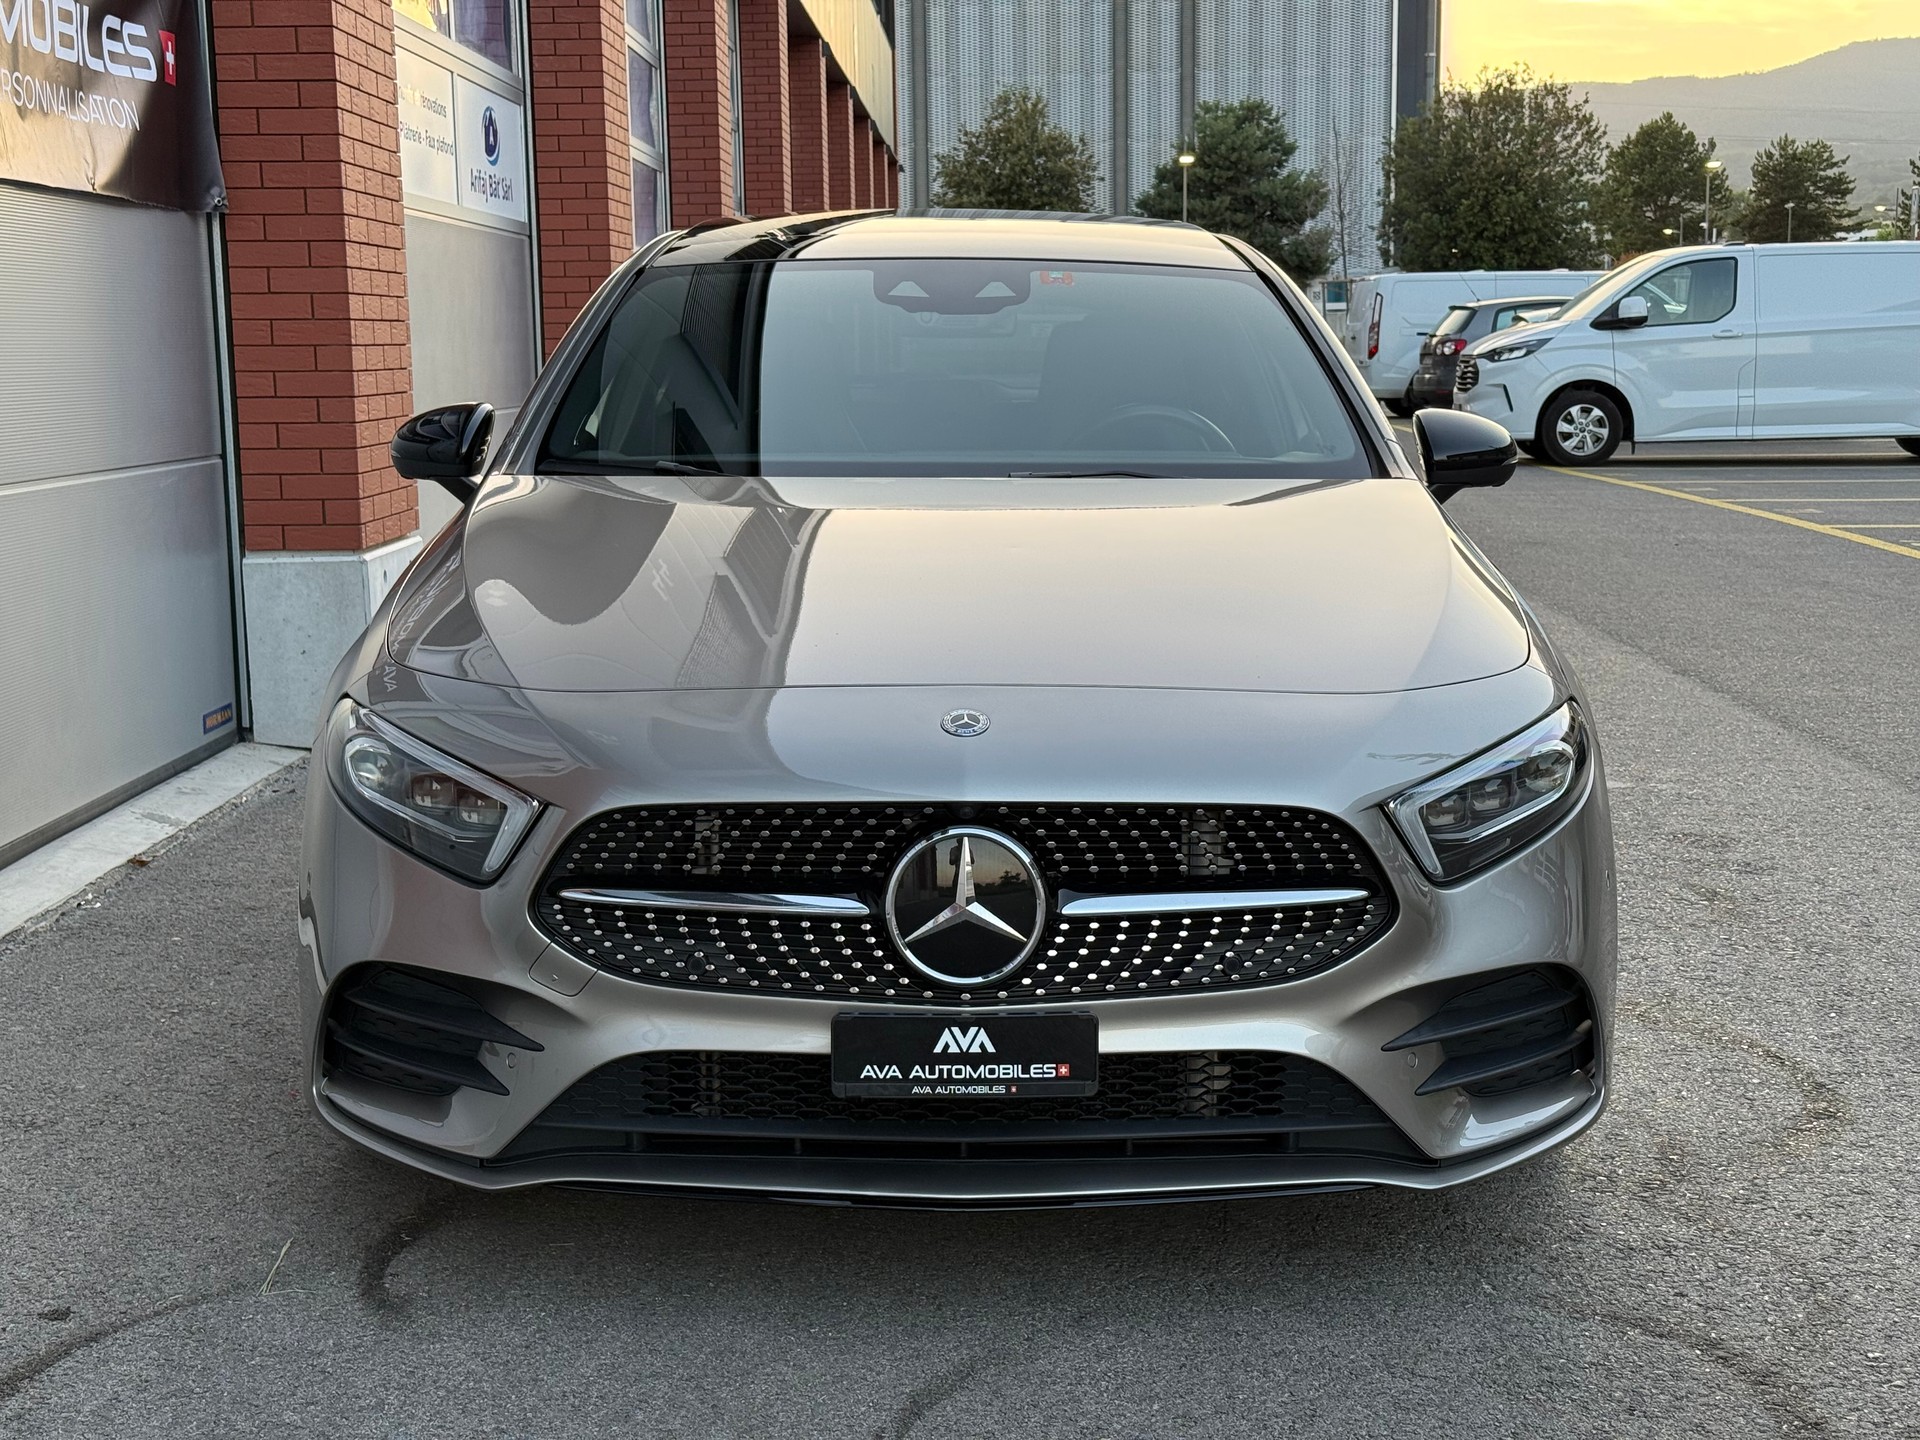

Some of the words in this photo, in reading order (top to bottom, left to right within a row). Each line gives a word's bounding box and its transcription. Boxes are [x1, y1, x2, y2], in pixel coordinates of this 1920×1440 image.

[0, 0, 157, 82] MOBILES
[932, 1026, 997, 1053] AVA
[860, 1064, 903, 1079] AVA
[908, 1063, 1057, 1079] AUTOMOBILES
[911, 1085, 933, 1094] AVA
[934, 1085, 1006, 1094] AUTOMOBILES
